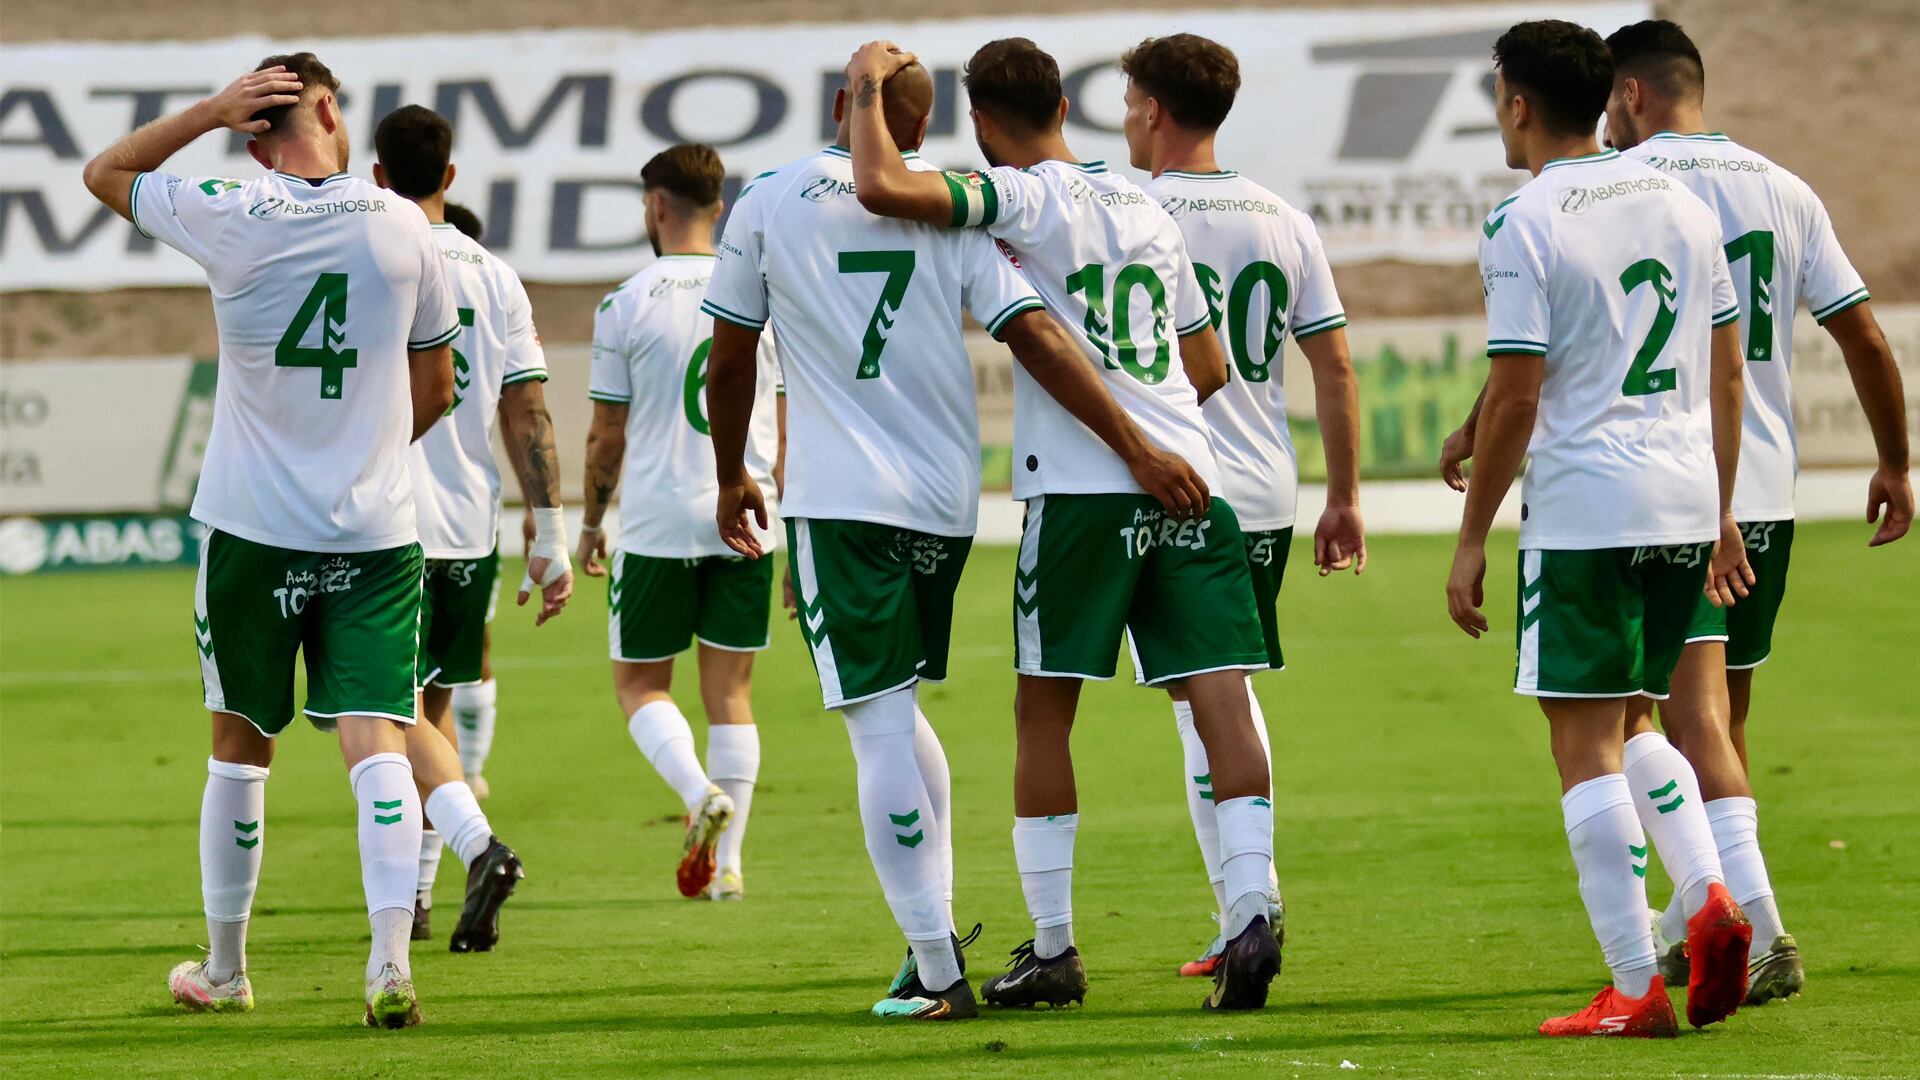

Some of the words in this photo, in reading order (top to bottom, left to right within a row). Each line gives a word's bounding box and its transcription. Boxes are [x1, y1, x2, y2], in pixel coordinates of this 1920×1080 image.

[1591, 178, 1673, 202] ABASTHOSUR
[1670, 157, 1770, 175] ABASTHOSUR
[284, 199, 388, 215] ABASTHOSUR
[1189, 199, 1279, 216] ABASTHOSUR
[274, 272, 358, 400] 4
[838, 250, 916, 380] 7
[1065, 263, 1171, 386] 10
[1618, 258, 1678, 397] 2
